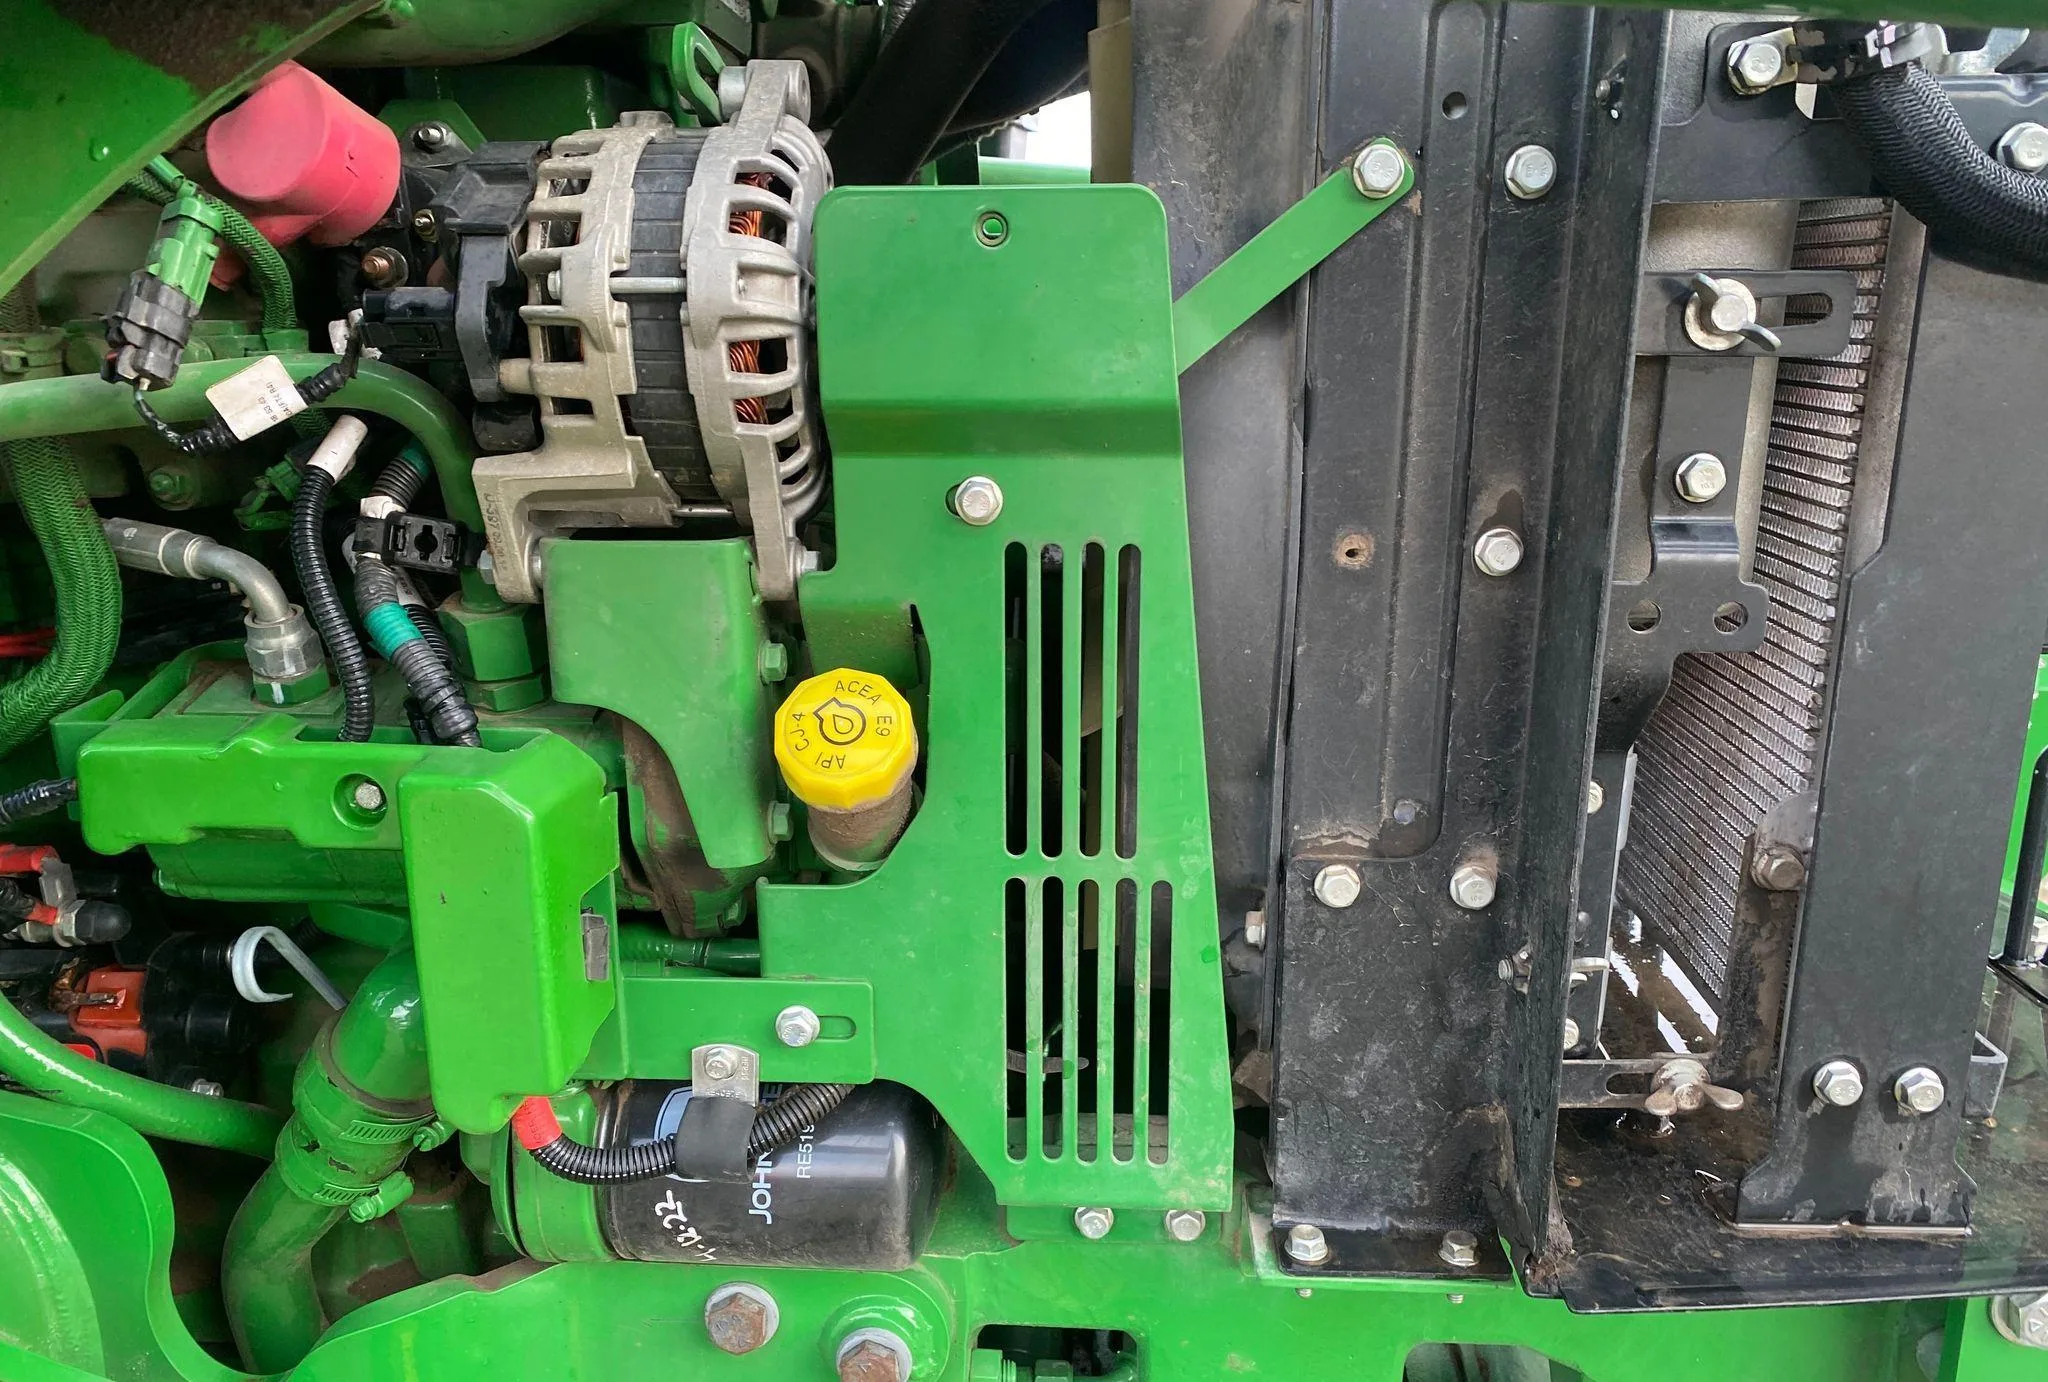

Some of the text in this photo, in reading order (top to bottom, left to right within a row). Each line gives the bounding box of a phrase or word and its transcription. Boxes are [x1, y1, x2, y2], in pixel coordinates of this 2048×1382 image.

[834, 680, 893, 737] ACEA E9
[790, 711, 846, 769] API CJ-4
